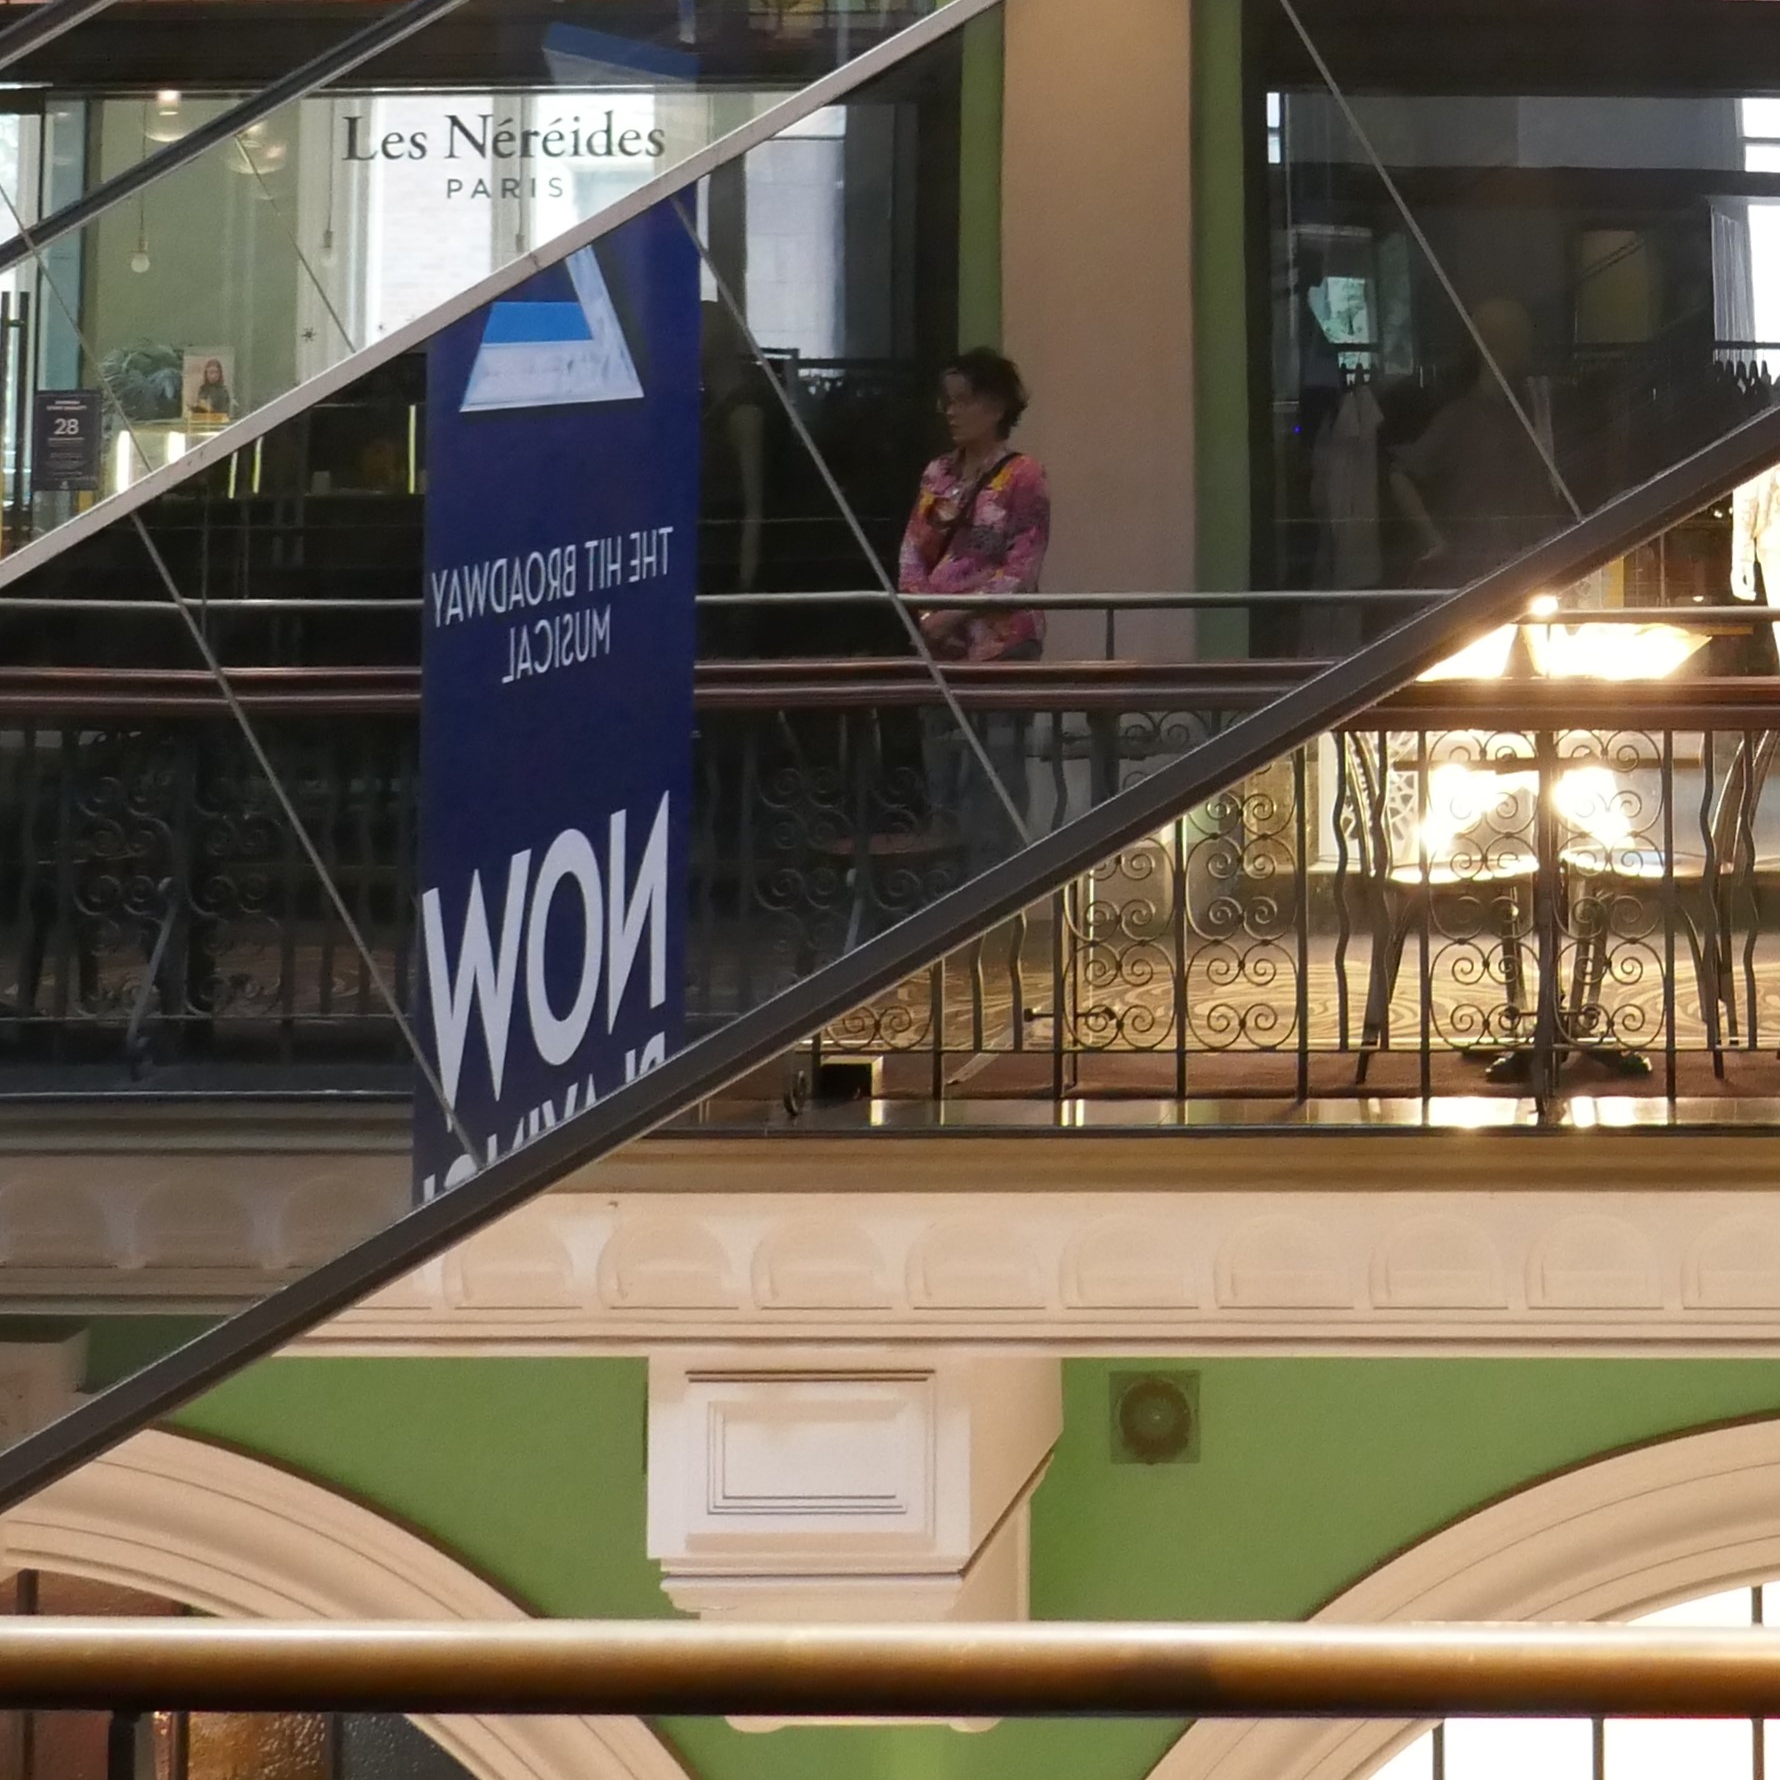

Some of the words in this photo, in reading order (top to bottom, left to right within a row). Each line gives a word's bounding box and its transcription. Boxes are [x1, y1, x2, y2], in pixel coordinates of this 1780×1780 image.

[342, 115, 428, 161] Les
[444, 110, 667, 160] Néréides
[447, 177, 564, 200] PARIS
[54, 417, 80, 435] 28
